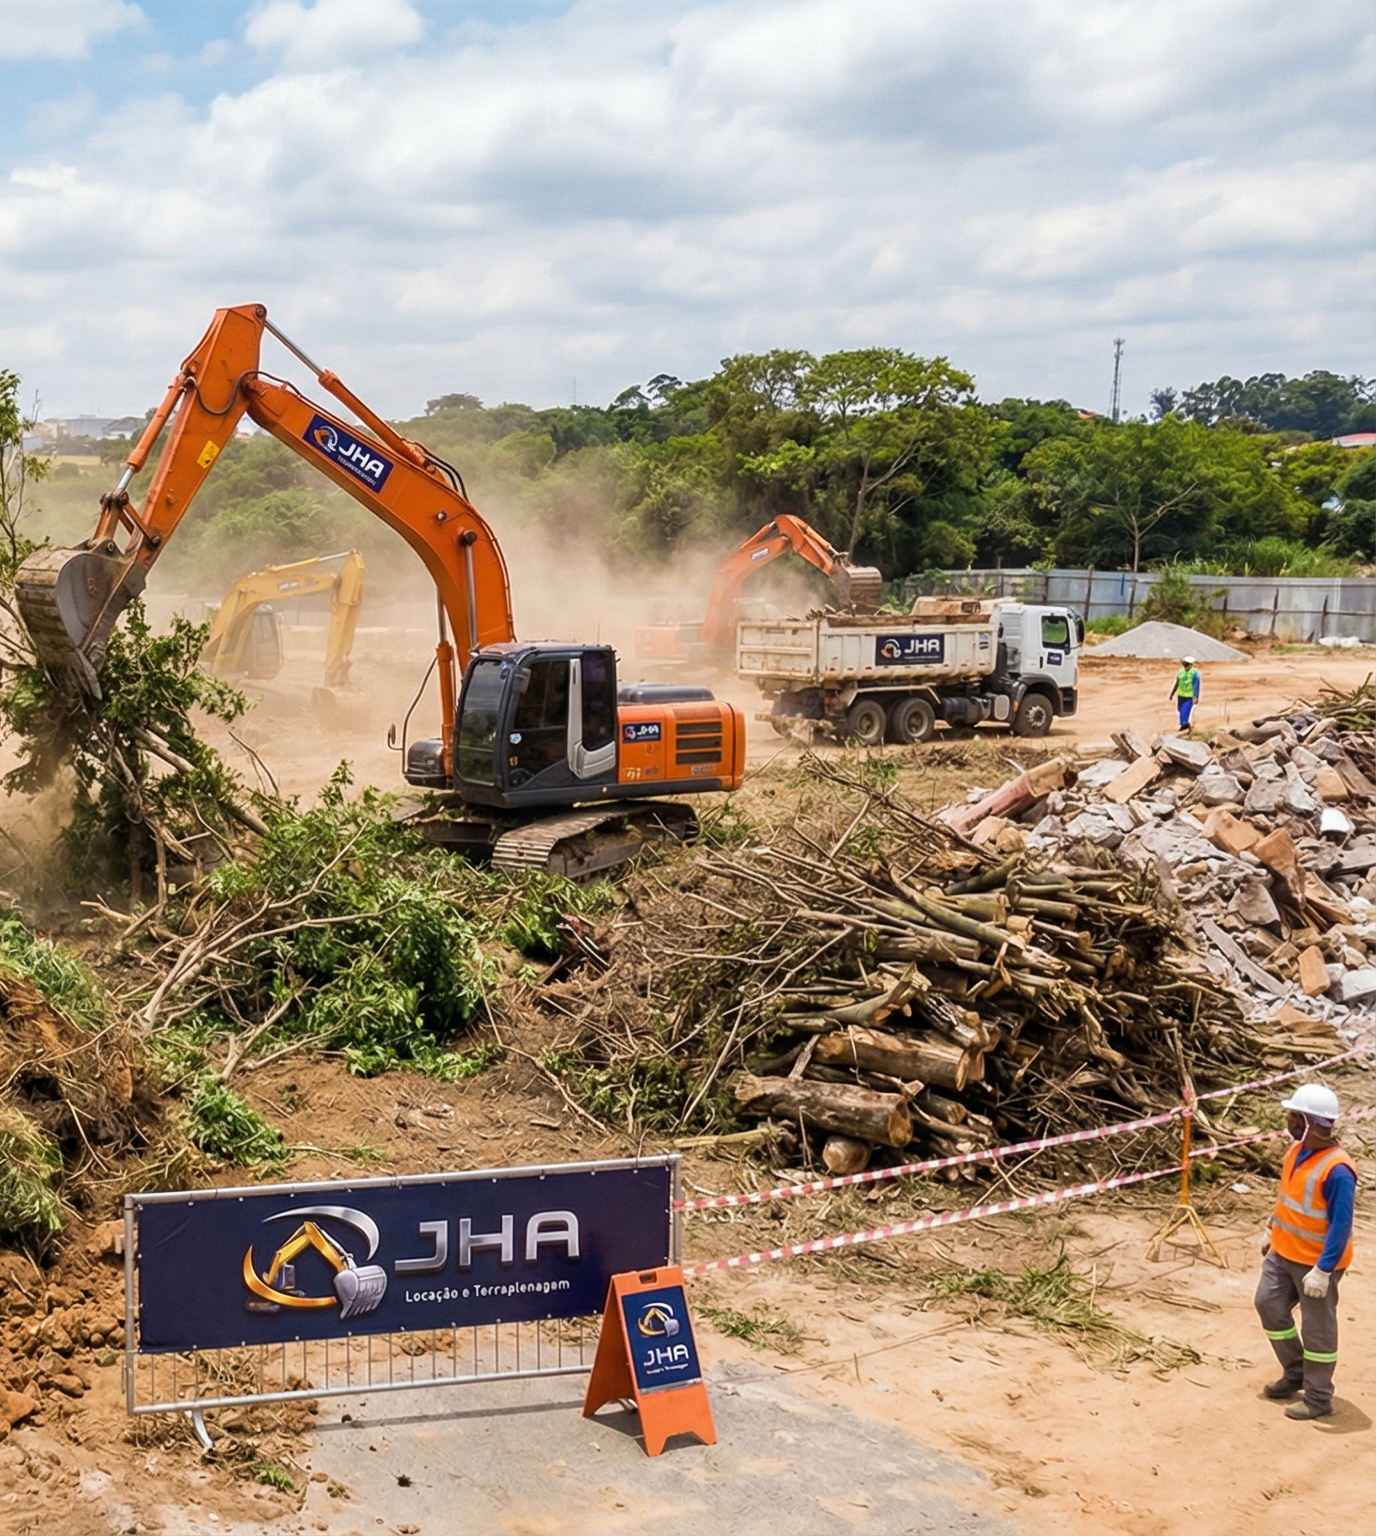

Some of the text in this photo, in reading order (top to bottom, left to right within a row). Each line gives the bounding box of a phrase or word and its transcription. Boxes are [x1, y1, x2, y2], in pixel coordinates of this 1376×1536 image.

[338, 443, 385, 478] JHA
[904, 639, 940, 653] JHA
[394, 1210, 580, 1272] JHA
[405, 1278, 571, 1303] Locação e Terraplenagem
[643, 1343, 690, 1367] JHA
